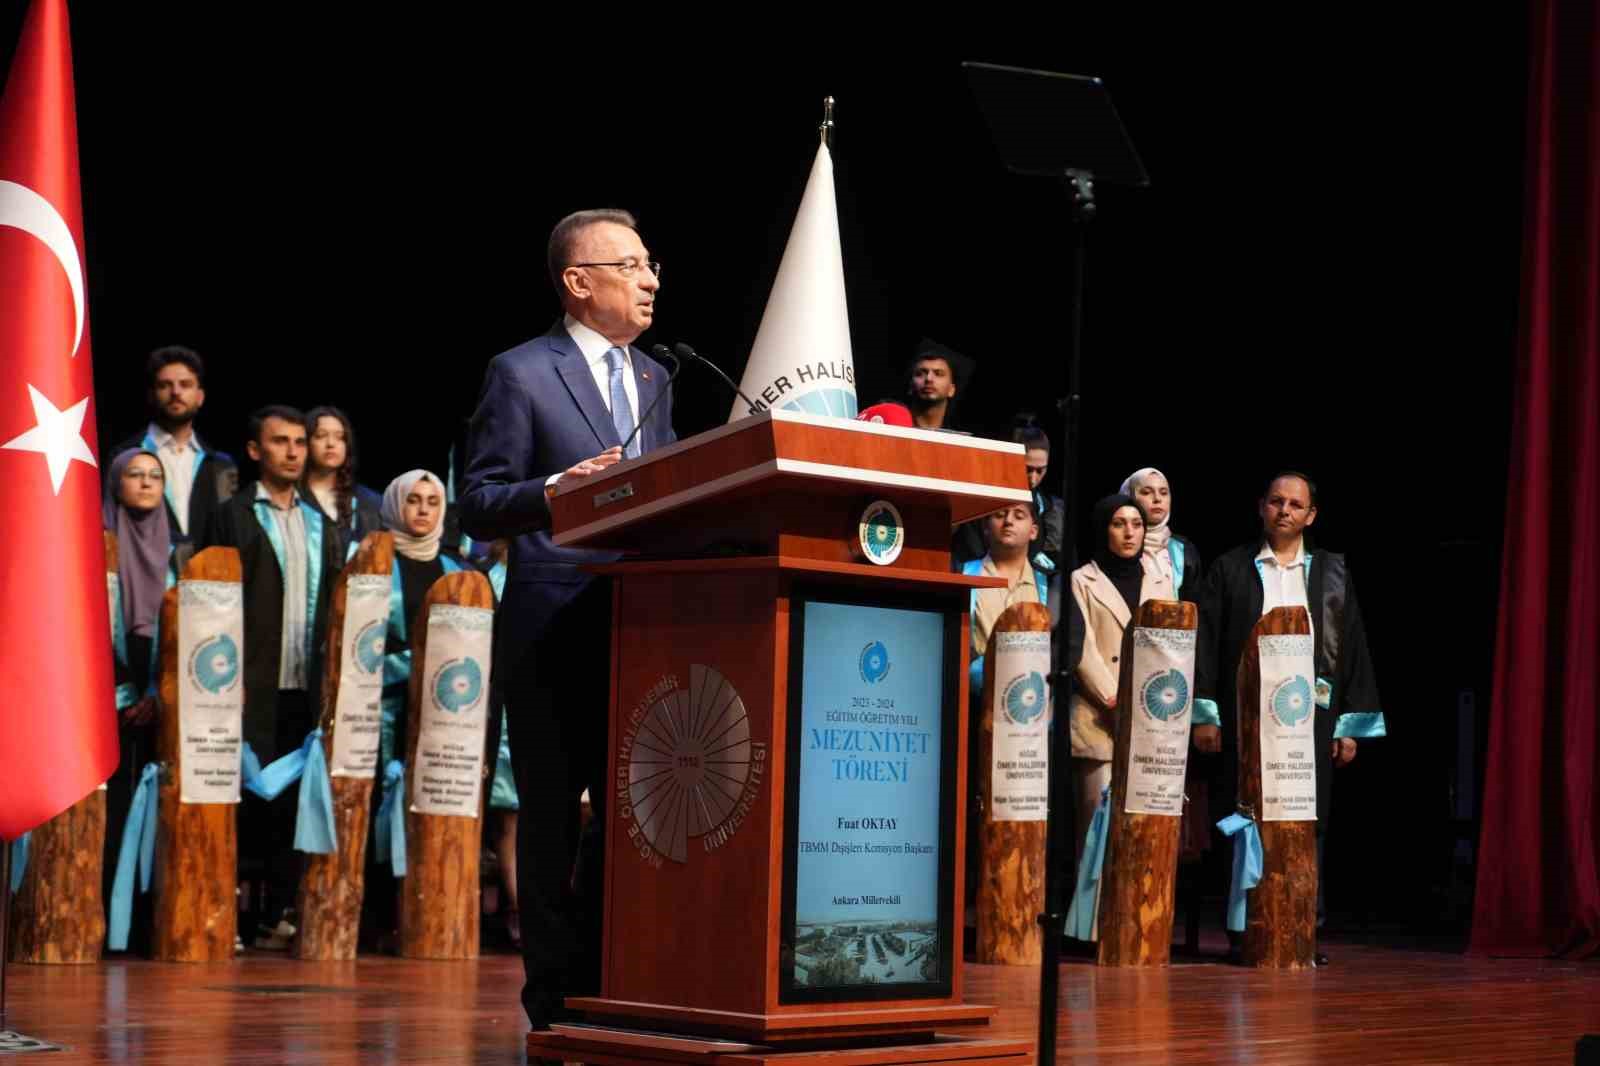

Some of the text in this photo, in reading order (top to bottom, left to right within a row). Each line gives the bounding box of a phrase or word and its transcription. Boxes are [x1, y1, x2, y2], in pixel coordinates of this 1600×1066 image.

[810, 727, 931, 754] MEZUNİYET
[832, 754, 908, 782] TÖRENİ
[837, 817, 898, 830] Fuat OKTAY
[799, 842, 829, 853] TBMM
[832, 896, 859, 905] Ankara
